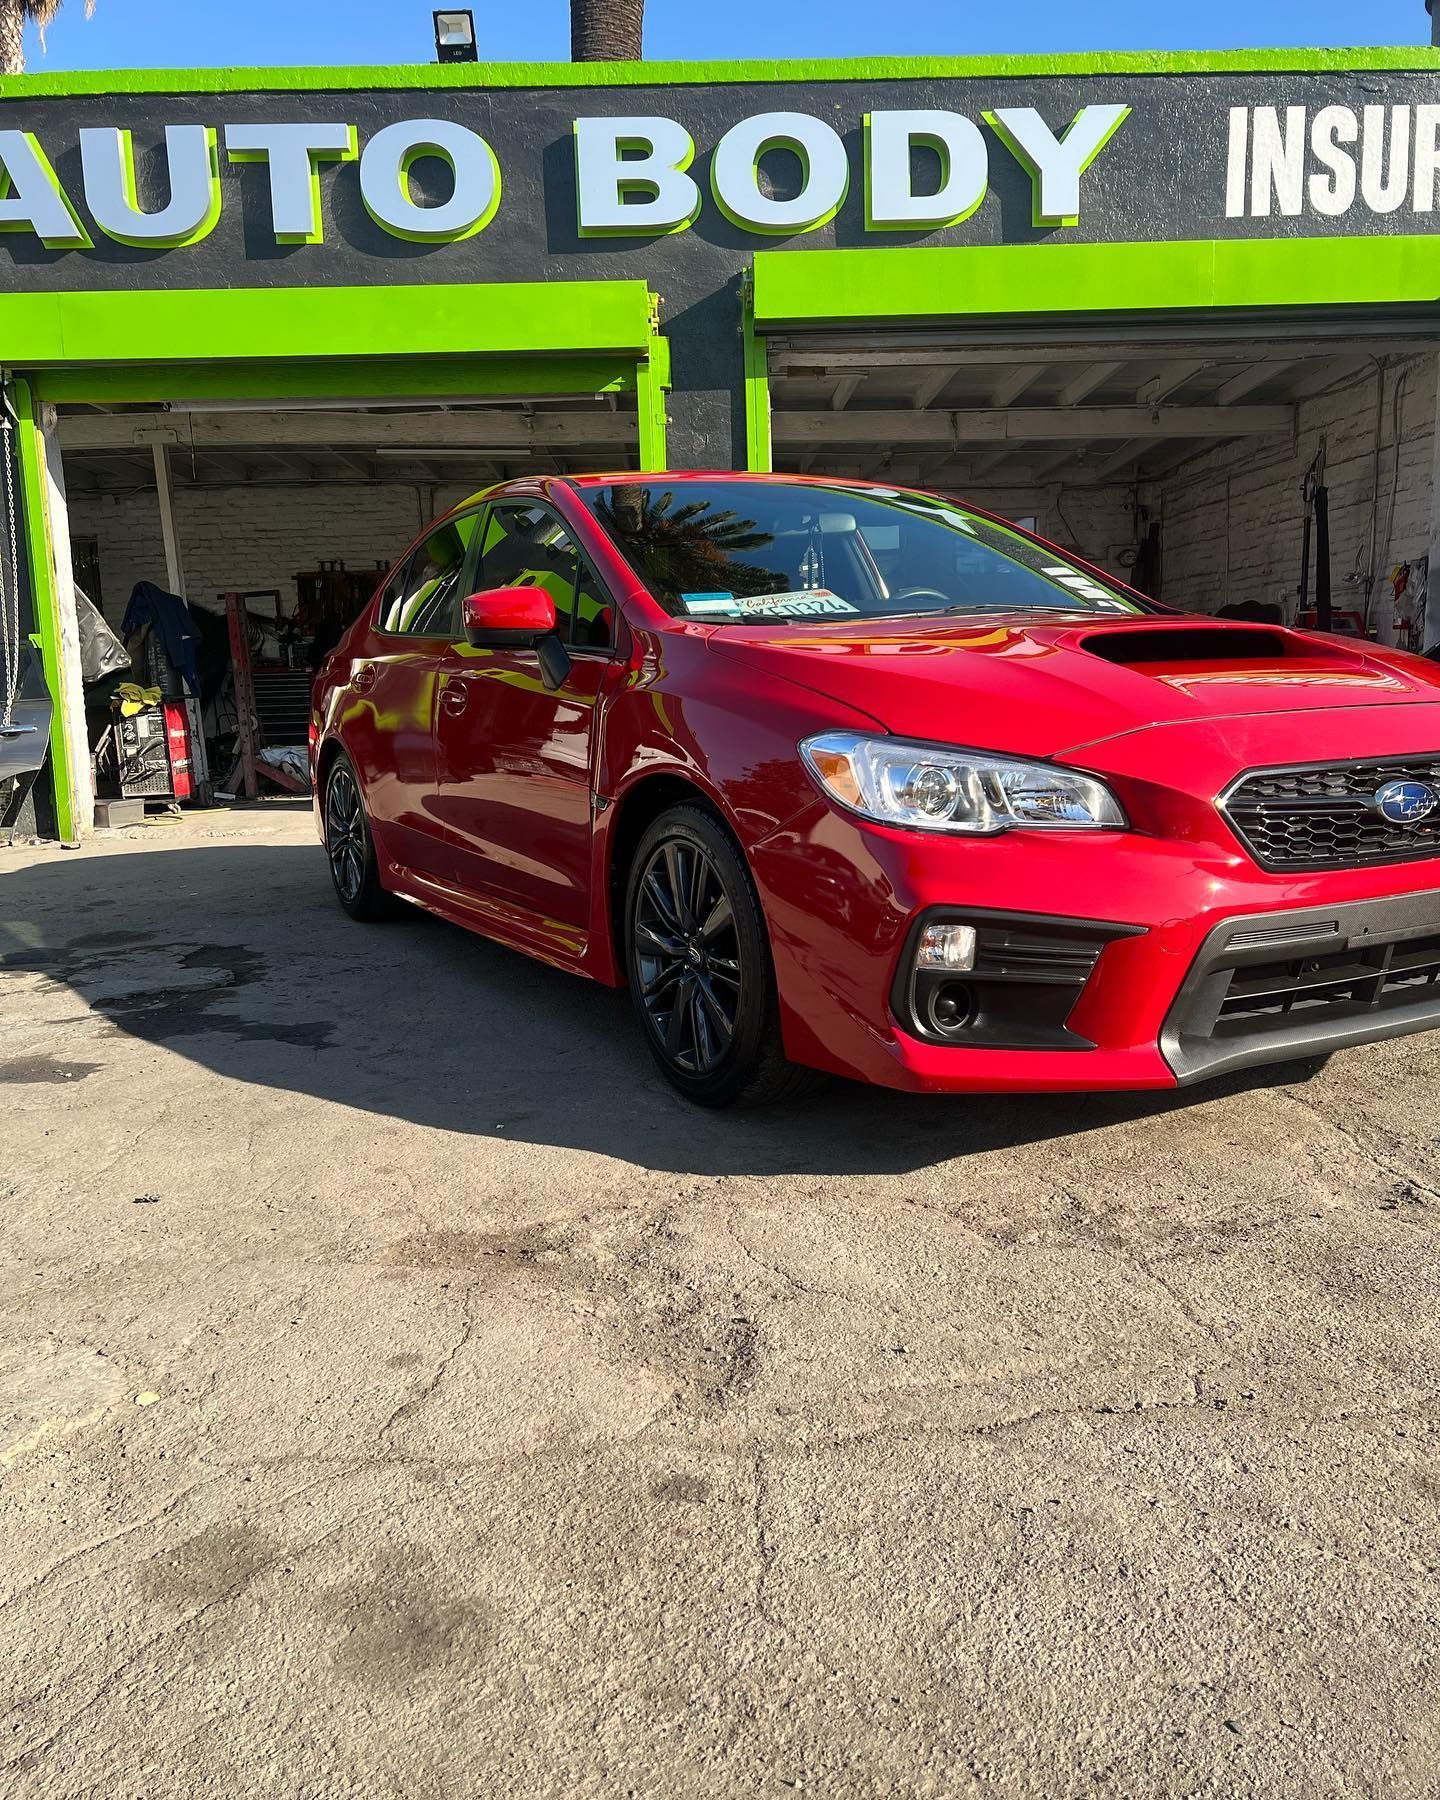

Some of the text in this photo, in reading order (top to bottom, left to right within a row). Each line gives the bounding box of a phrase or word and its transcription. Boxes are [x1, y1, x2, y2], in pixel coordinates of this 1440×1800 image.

[0, 104, 1131, 249] AUTO BODY
[746, 595, 807, 608] California
